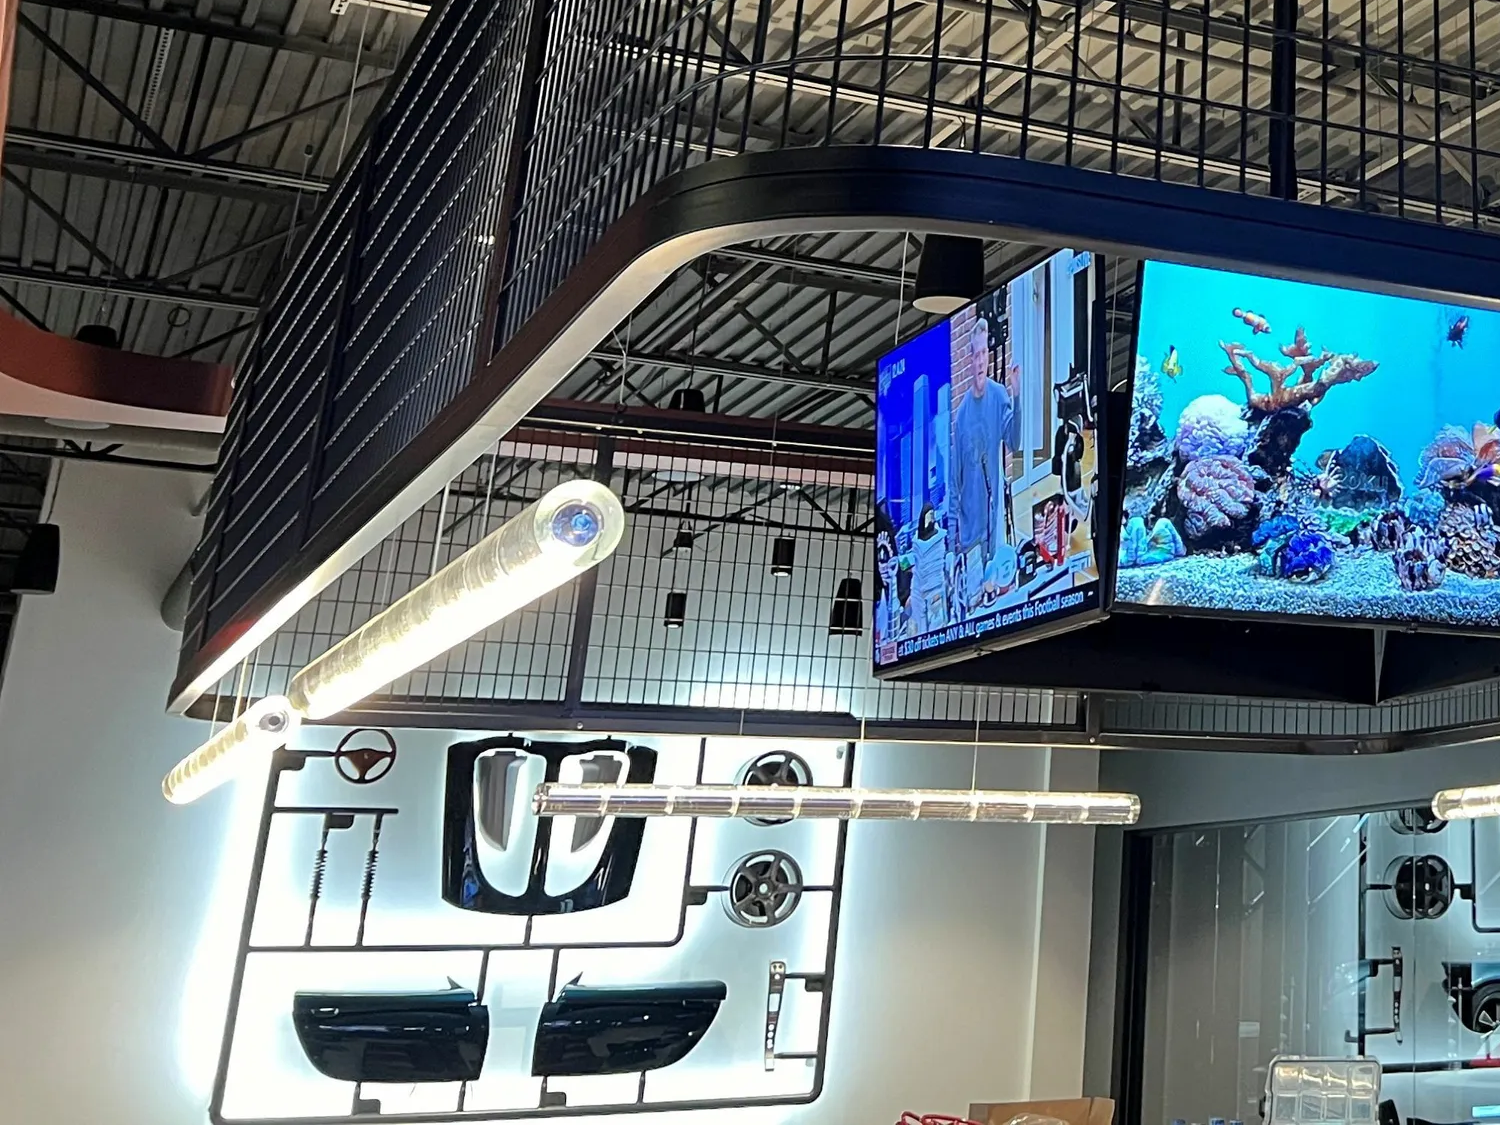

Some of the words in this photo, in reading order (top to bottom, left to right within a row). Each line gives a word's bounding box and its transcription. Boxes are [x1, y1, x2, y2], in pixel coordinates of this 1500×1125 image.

[945, 625, 959, 643] ANY
[965, 620, 976, 637] ALL
[975, 617, 995, 639] games
[995, 612, 1002, 628] &
[1002, 608, 1022, 626] events
[1022, 603, 1034, 620] this
[1034, 593, 1061, 616] Football
[1060, 590, 1084, 609] season
